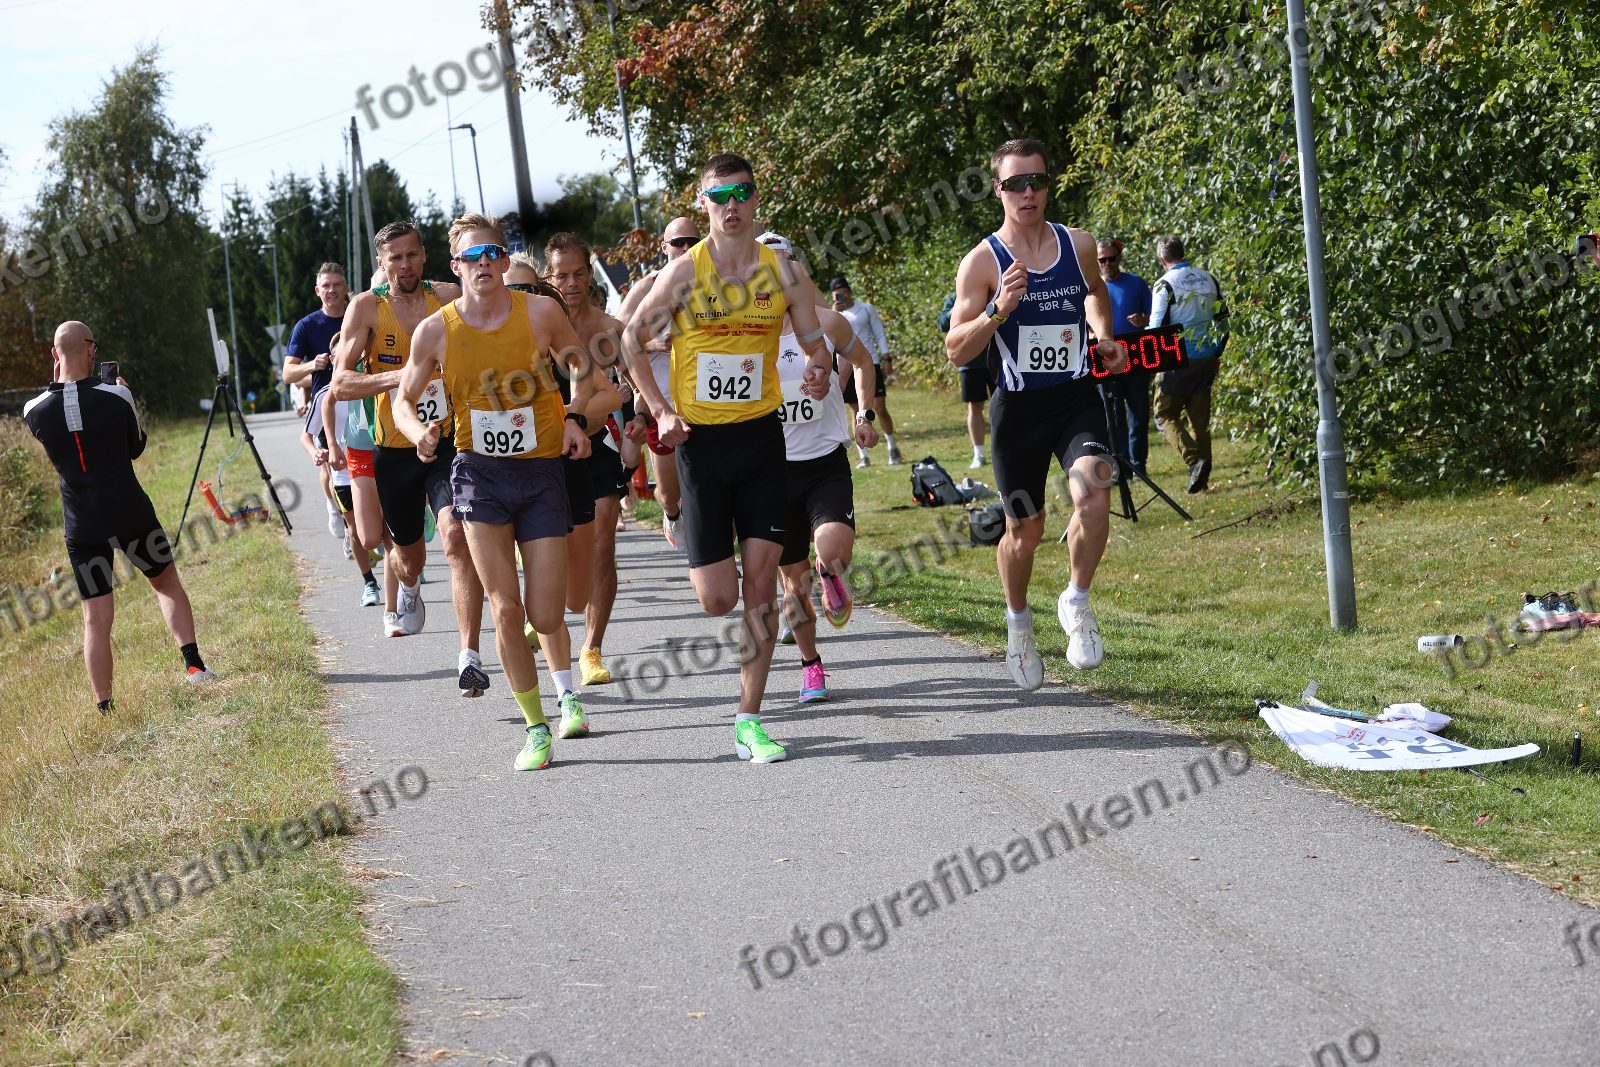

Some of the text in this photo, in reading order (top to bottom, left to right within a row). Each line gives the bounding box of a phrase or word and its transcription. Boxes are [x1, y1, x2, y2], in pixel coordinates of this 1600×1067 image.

[1038, 300, 1060, 312] SØR
[1029, 346, 1069, 371] 993
[708, 375, 752, 400] 942
[777, 398, 814, 423] 976
[483, 429, 525, 454] 992
